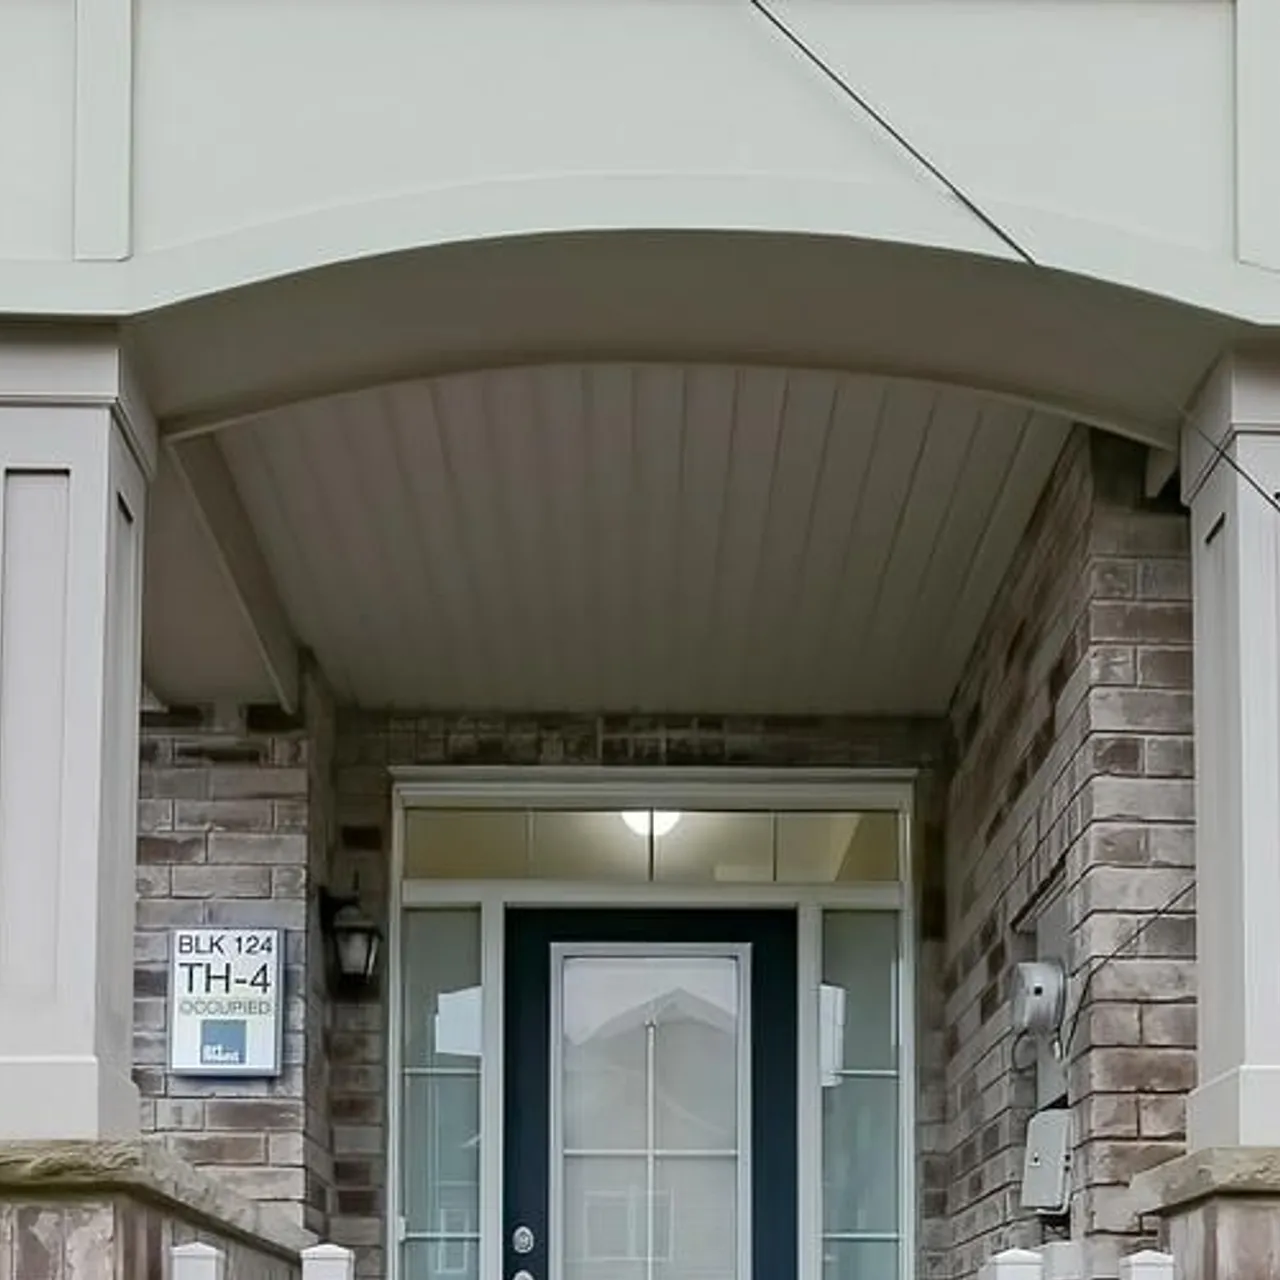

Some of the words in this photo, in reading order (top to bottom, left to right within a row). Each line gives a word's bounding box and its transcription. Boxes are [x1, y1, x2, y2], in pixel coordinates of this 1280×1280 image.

[178, 935, 224, 954] BLK
[235, 935, 273, 954] 124
[179, 962, 271, 994] TH-4
[178, 1000, 271, 1016] OCCUPIED
